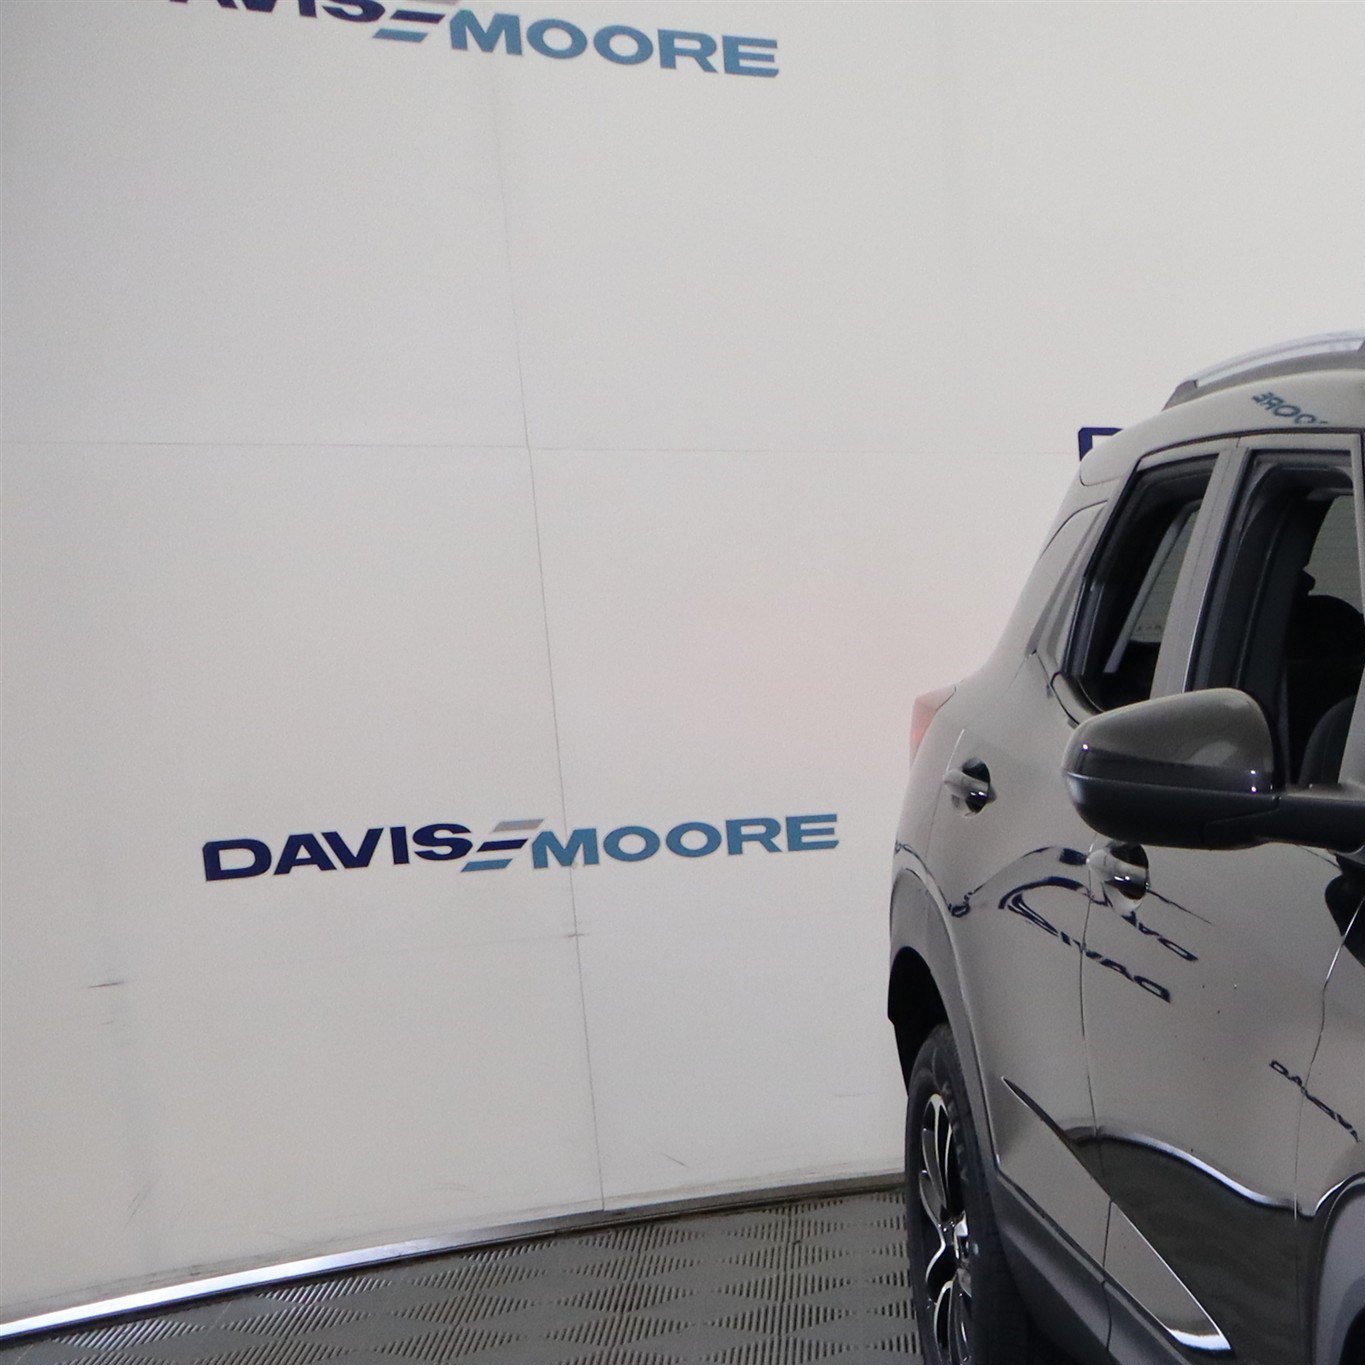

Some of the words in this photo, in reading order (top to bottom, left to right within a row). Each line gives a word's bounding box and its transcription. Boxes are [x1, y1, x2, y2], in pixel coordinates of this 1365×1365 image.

[449, 9, 779, 78] MOORE
[201, 822, 474, 883] DAVIS
[531, 813, 840, 870] MOORE
